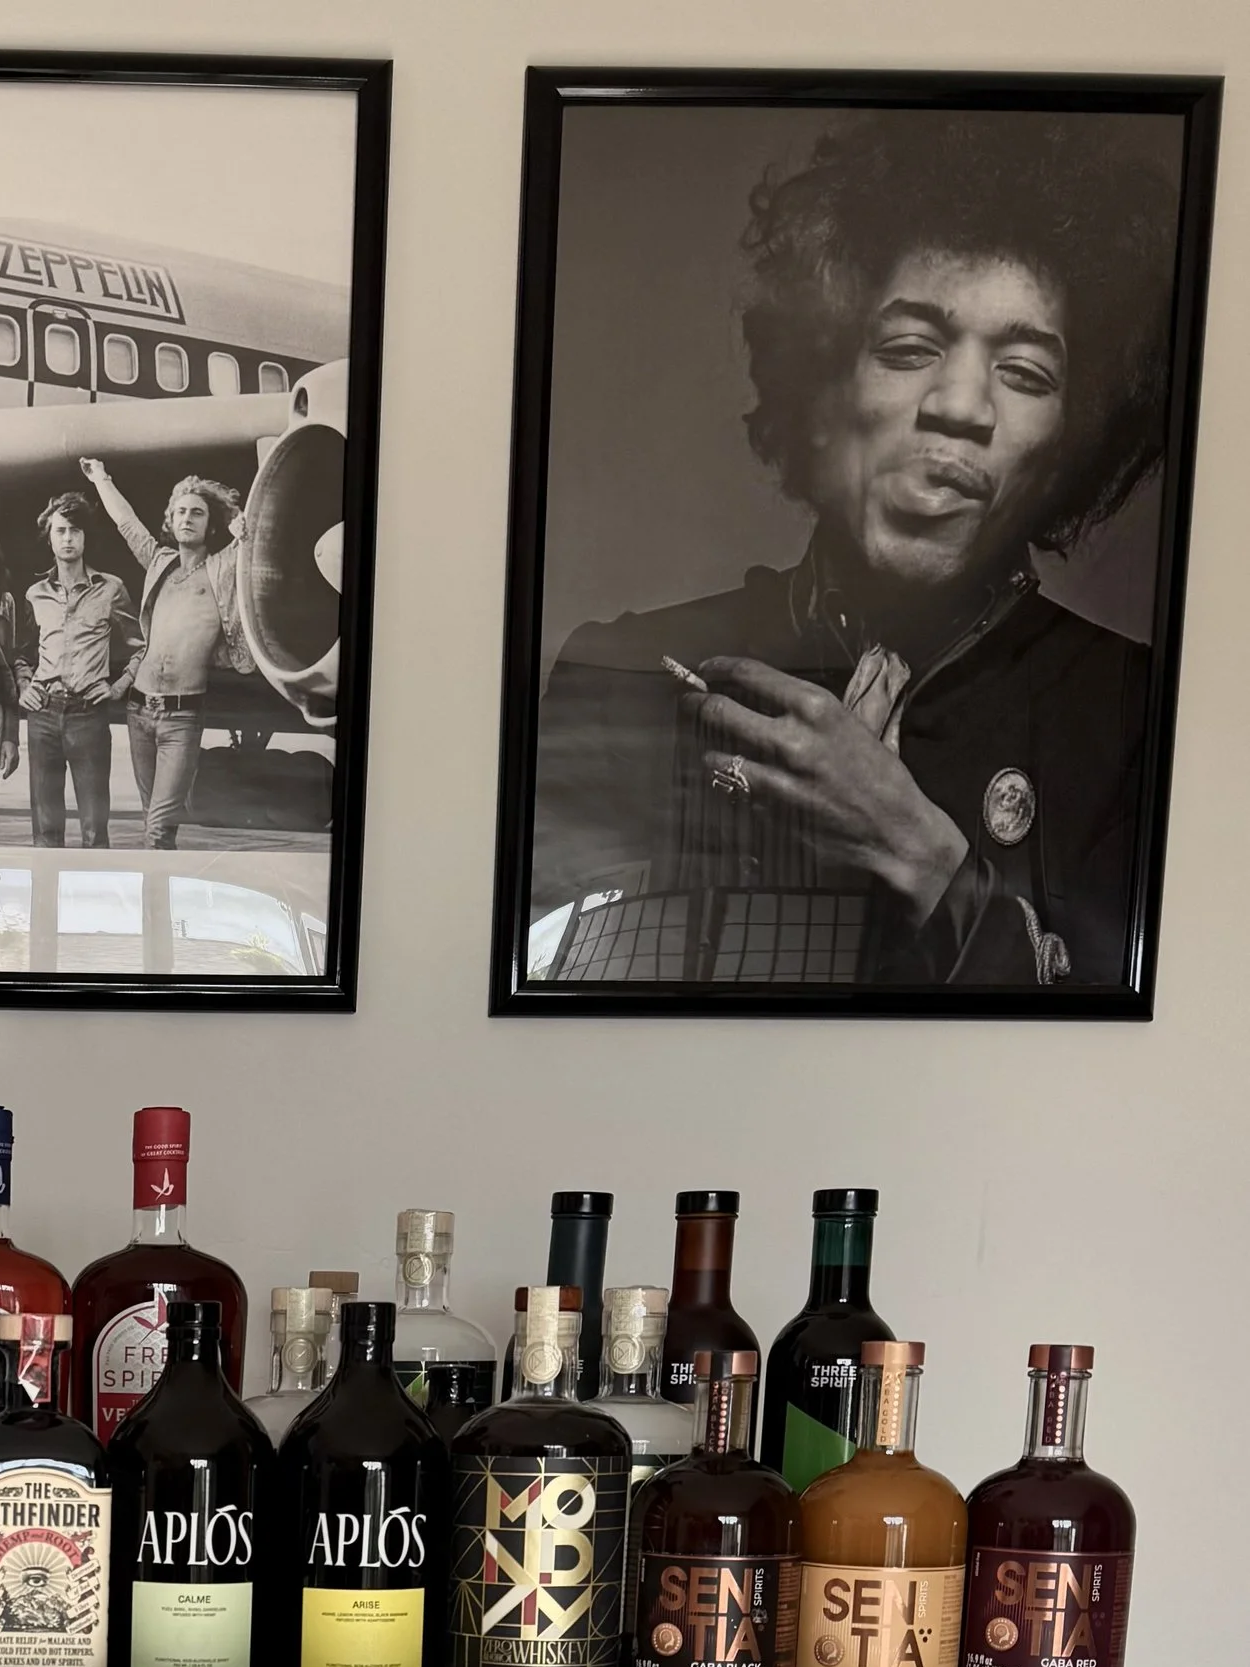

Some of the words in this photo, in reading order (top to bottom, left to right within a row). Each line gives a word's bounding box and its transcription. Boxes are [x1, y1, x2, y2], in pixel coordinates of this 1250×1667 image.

[812, 1365, 857, 1376] THREE
[810, 1377, 857, 1388] SPIRIT
[25, 1482, 51, 1499] THE
[45, 1532, 79, 1558] ROOT
[660, 1565, 754, 1614] SEN
[754, 1568, 765, 1606] SPIRITS
[994, 1560, 1092, 1609] SEN
[1092, 1564, 1103, 1602] SPIRITS
[178, 1595, 211, 1604] CALME
[352, 1601, 380, 1609] ARISE
[822, 1578, 917, 1626] SEN
[918, 1580, 929, 1617] SPIRITS
[15, 1636, 38, 1645] RELIEF
[47, 1637, 76, 1645] MALAISE
[77, 1637, 92, 1645] AND
[688, 1616, 762, 1662] TIA
[1024, 1610, 1098, 1658] TIA
[3, 1657, 25, 1666] KNEES
[26, 1658, 40, 1666] AND
[42, 1658, 56, 1666] LOW
[15, 1647, 31, 1655] FEET
[32, 1647, 47, 1656] AND
[49, 1647, 62, 1656] HOT
[512, 1641, 587, 1664] WHISKEY
[967, 1653, 979, 1664] 16.9
[985, 1658, 993, 1666] oz
